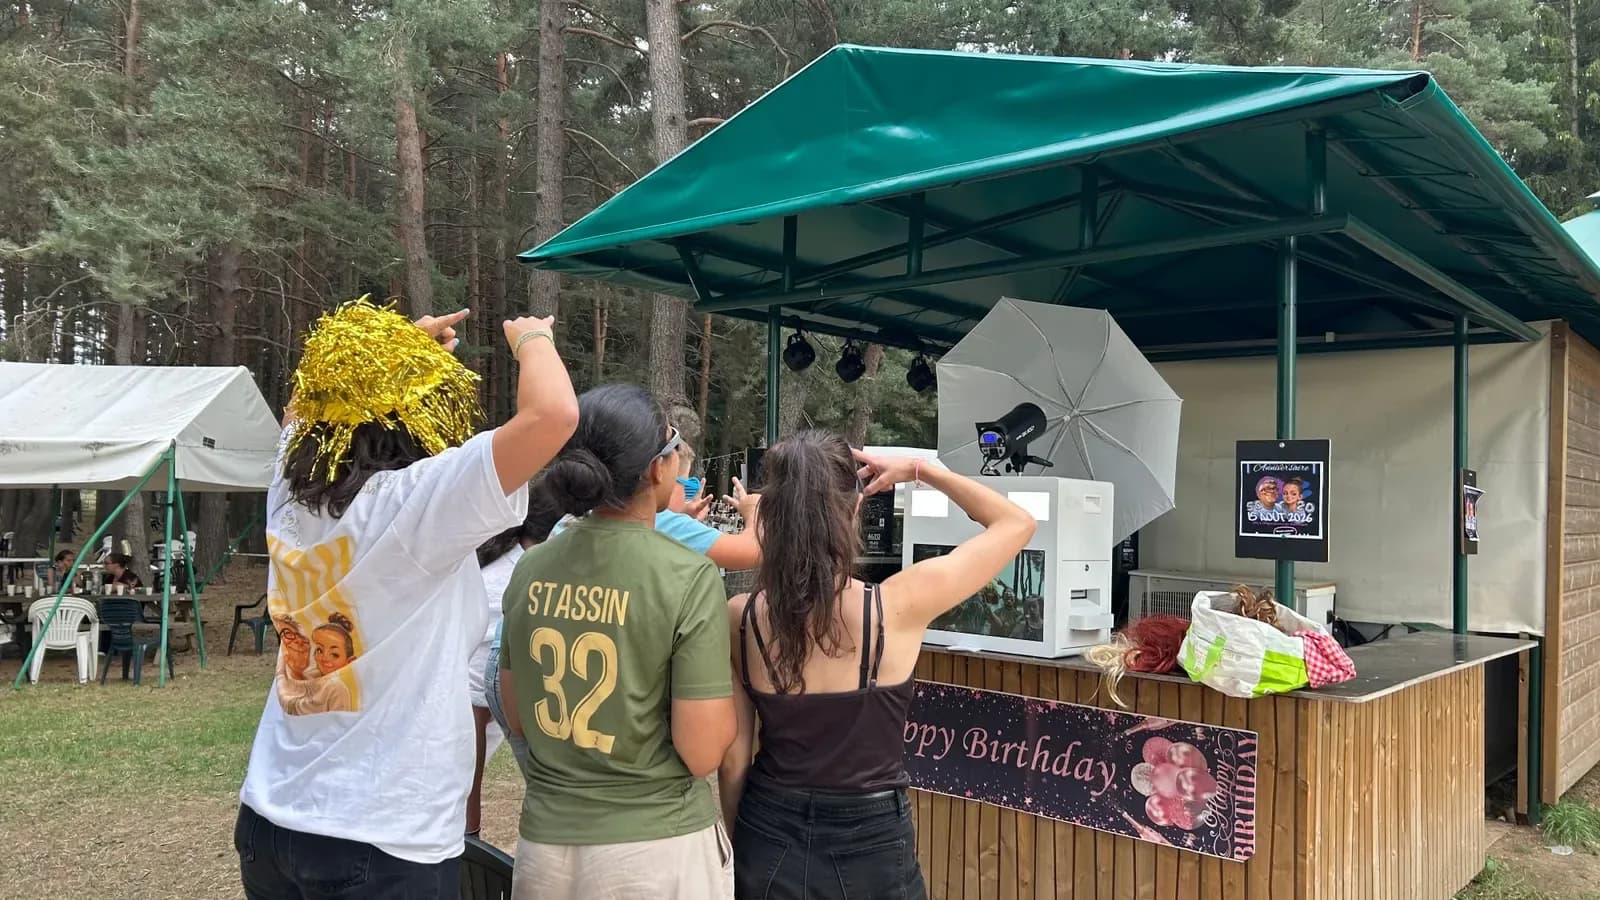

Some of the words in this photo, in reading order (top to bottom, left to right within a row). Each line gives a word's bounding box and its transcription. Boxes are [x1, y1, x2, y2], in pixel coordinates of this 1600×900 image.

[1247, 511, 1258, 521] 15
[1287, 512, 1313, 523] 2026
[528, 580, 630, 626] STASSIN
[529, 626, 618, 755] 32
[903, 720, 956, 761] ppy
[962, 727, 1116, 796] Birthday
[1201, 744, 1237, 843] Happy
[1233, 732, 1258, 861] BIRTHDAY
